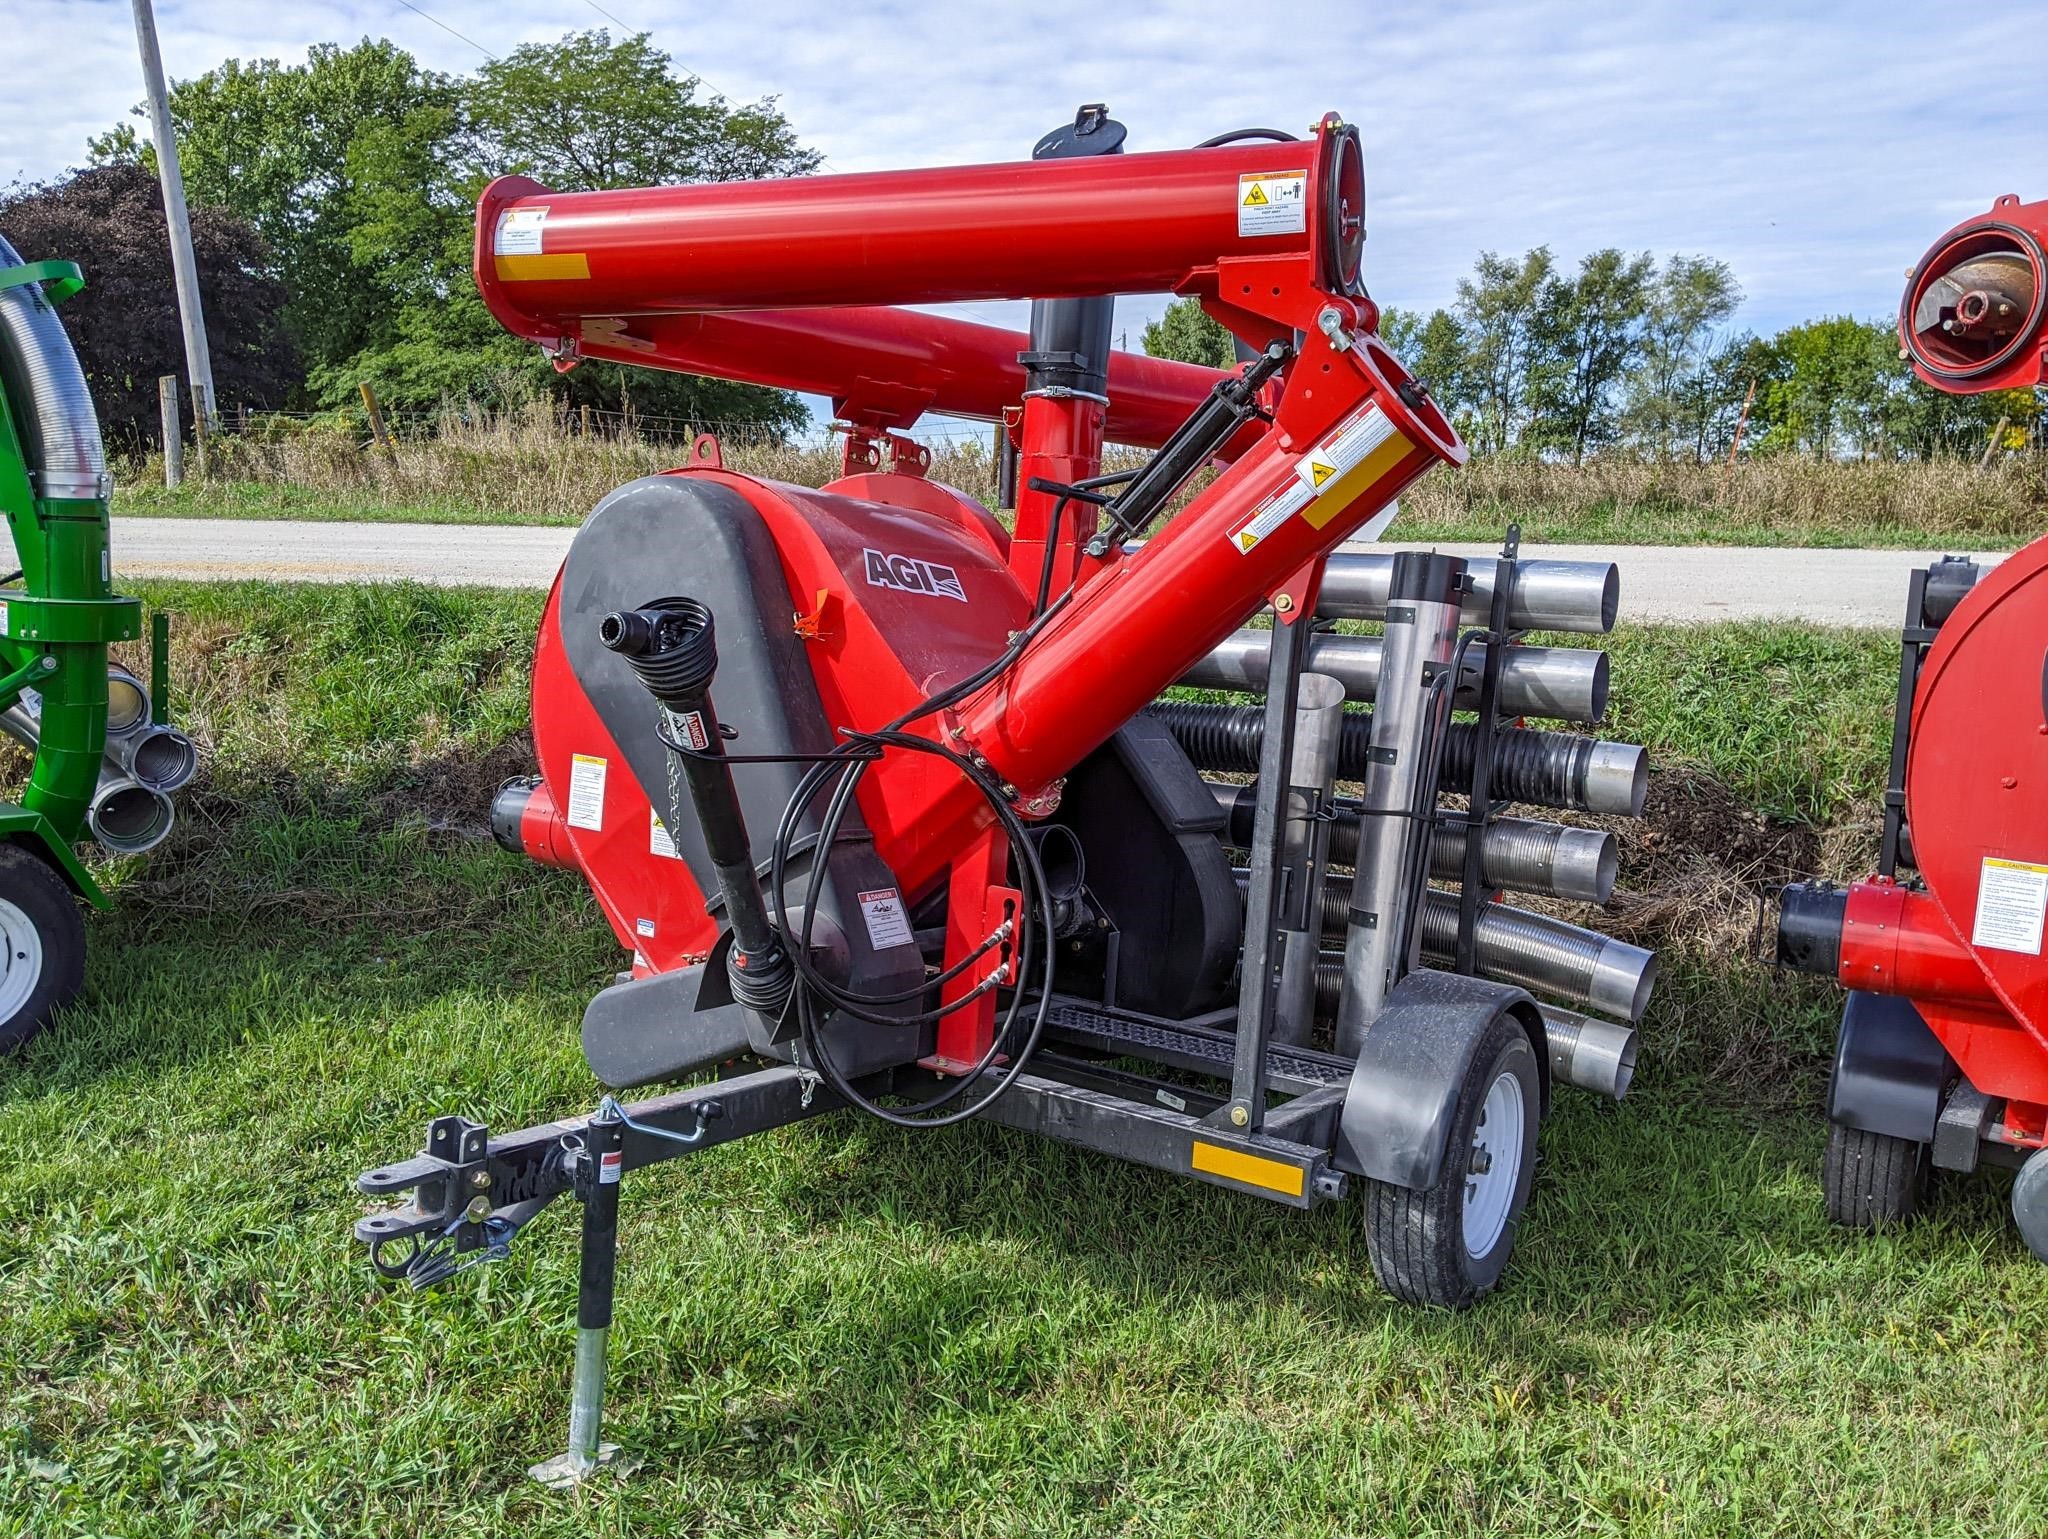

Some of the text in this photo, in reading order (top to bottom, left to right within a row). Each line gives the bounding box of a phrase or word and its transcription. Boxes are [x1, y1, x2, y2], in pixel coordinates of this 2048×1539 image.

[1340, 415, 1360, 432] DANGER
[1257, 495, 1276, 512] DANGER
[864, 549, 937, 596] AGI
[690, 722, 704, 748] DANGER
[871, 891, 892, 900] DANGER
